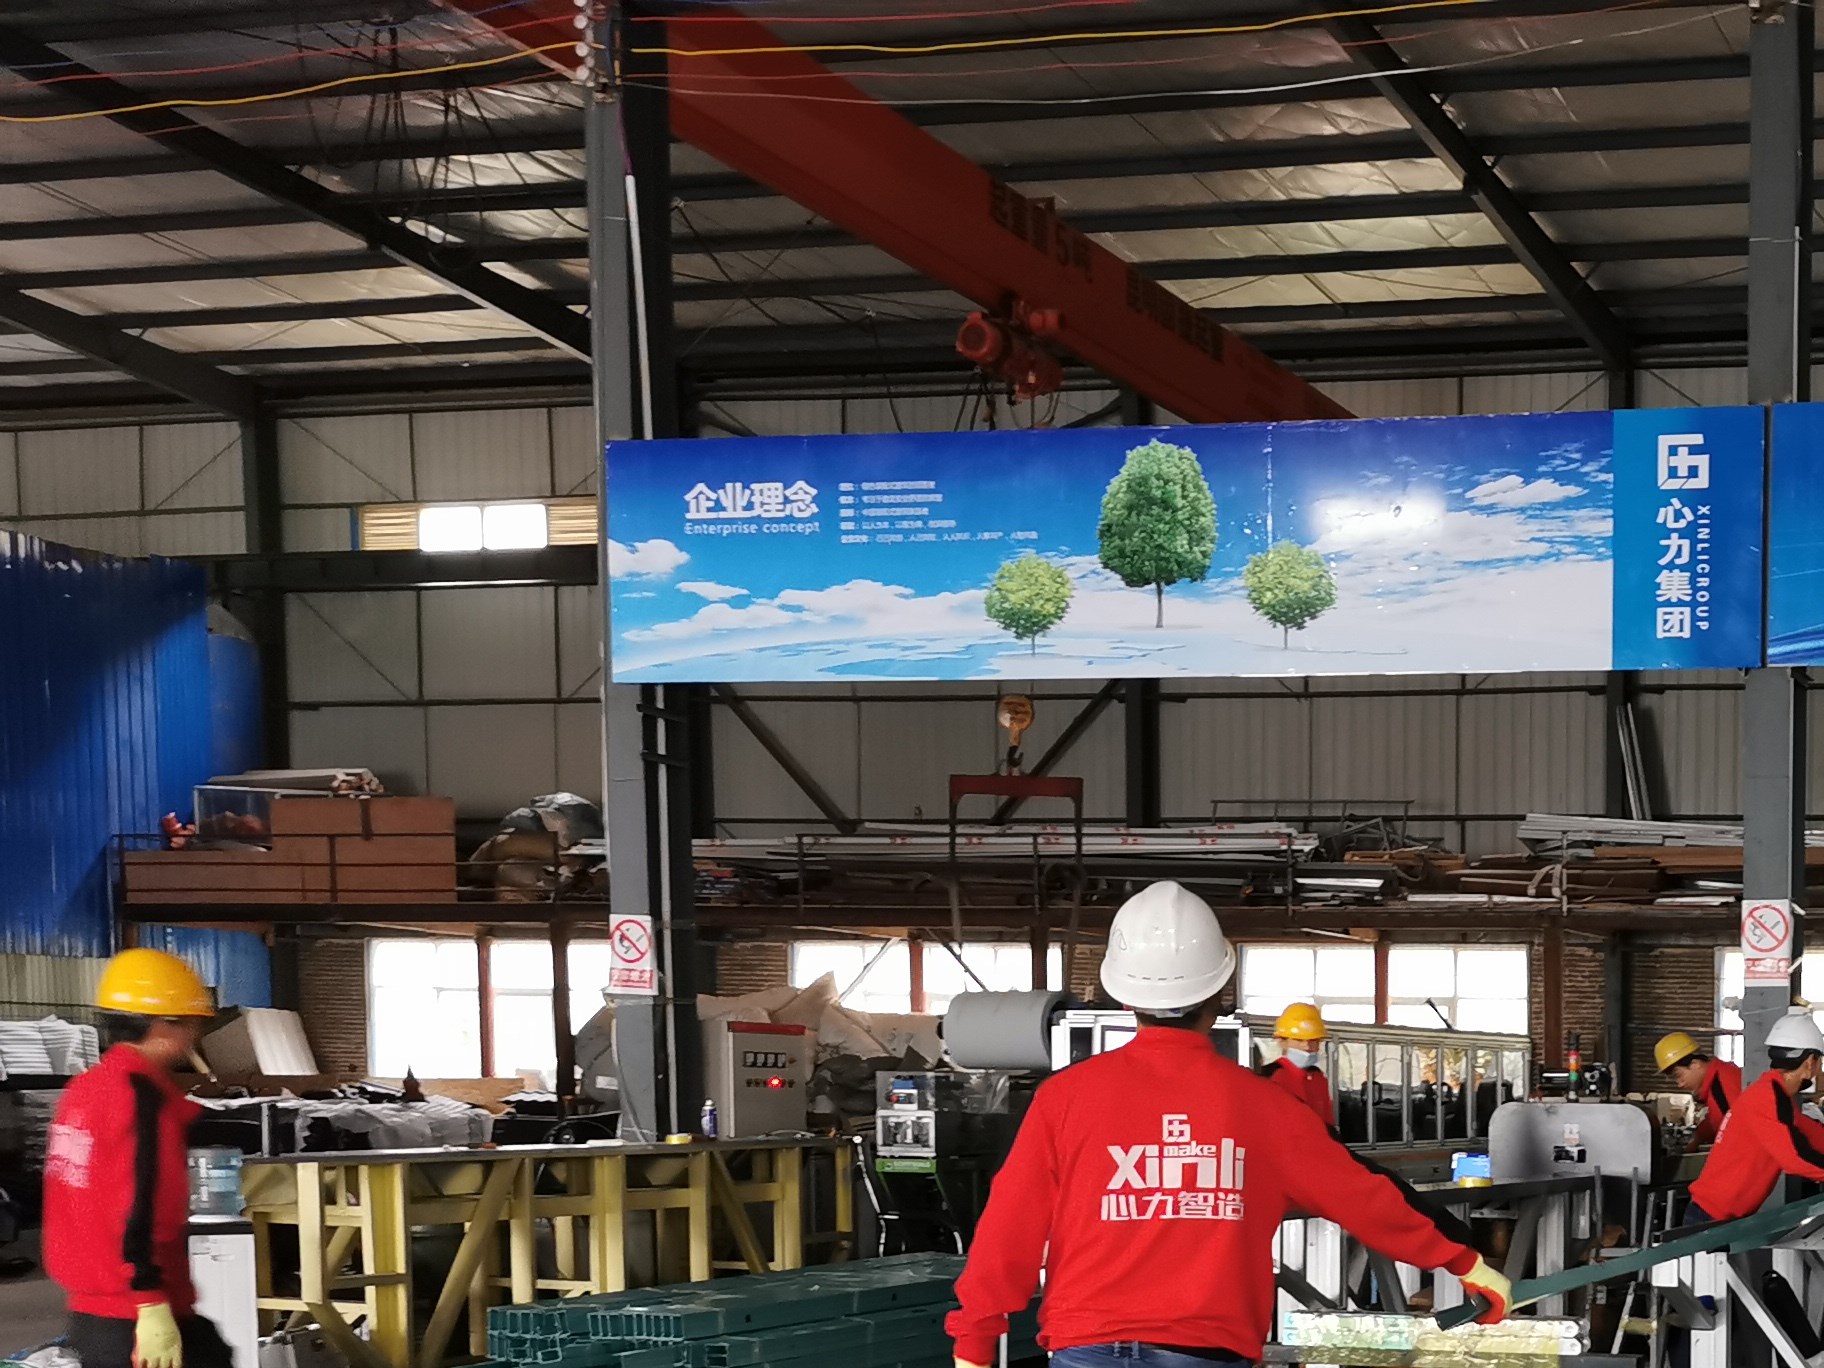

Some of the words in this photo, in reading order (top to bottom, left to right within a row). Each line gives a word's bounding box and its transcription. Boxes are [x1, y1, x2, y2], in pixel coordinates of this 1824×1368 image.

[683, 480, 820, 519] 企业理念
[684, 521, 759, 536] Enterprise
[762, 521, 820, 535] concept
[1654, 497, 1695, 639] 心力集团
[1163, 1141, 1217, 1157] make
[1101, 1191, 1245, 1221] 心力智造
